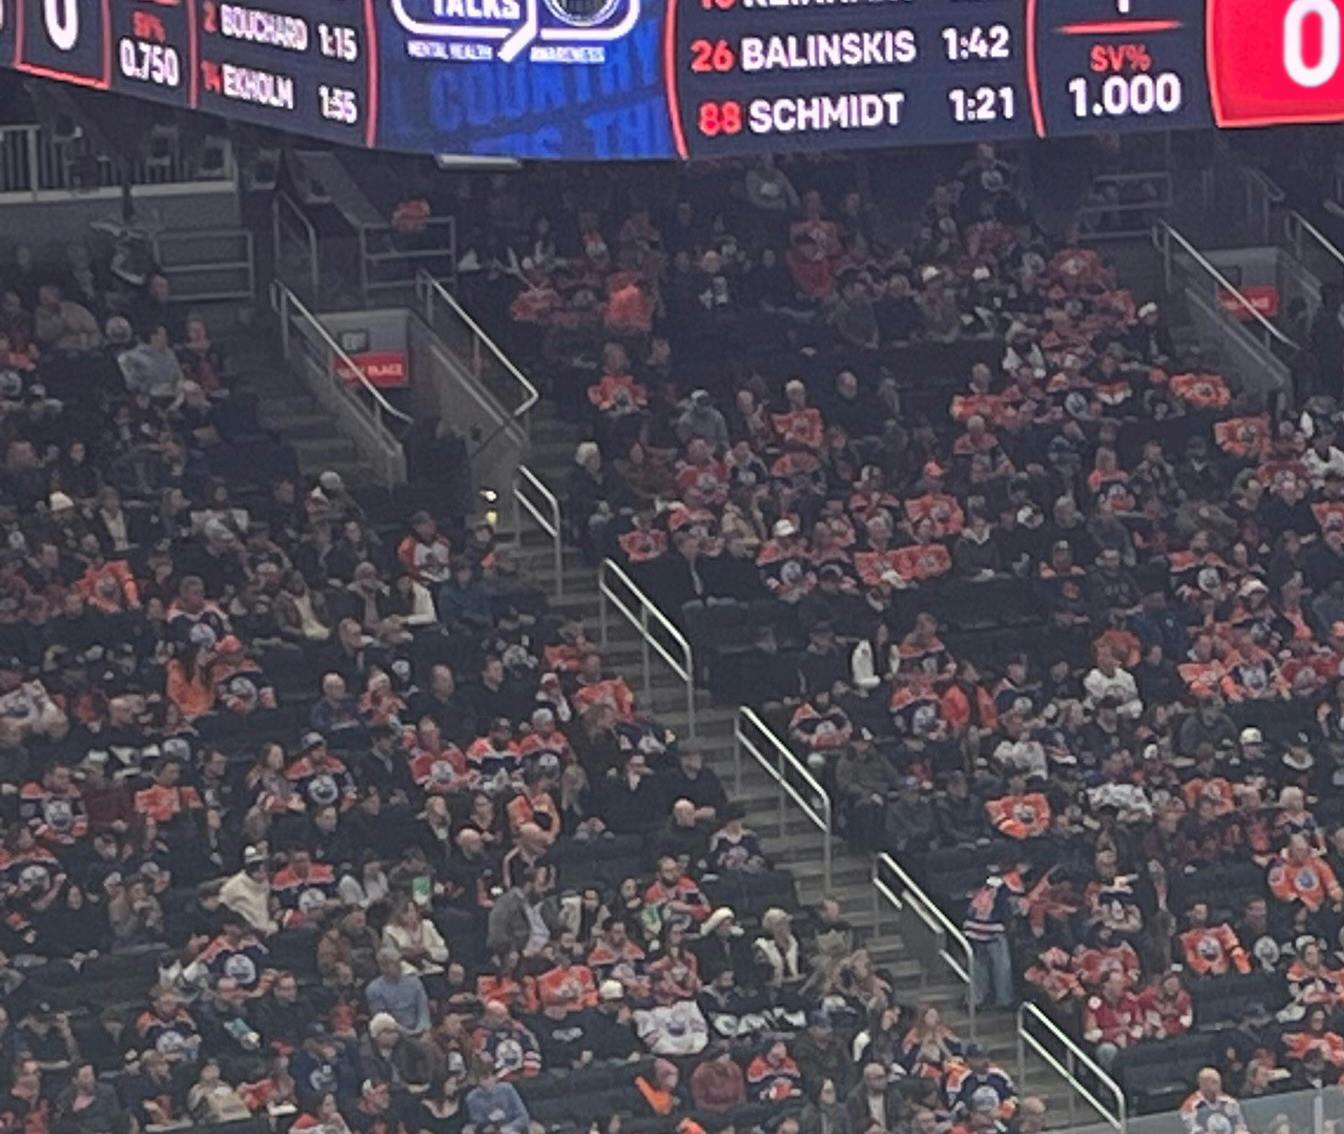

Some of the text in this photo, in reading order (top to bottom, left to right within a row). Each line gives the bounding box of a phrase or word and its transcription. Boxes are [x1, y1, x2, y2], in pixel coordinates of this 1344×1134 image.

[220, 4, 308, 50] BOUCHARD
[318, 24, 358, 61] 1:15
[690, 26, 1010, 72] 26 BALINSKIS 1:42
[1283, 0, 1341, 88] 0
[119, 38, 180, 86] 0.750
[1090, 45, 1151, 72] SV%
[222, 64, 294, 110] EKHOLM
[319, 85, 358, 123] 1:55
[699, 86, 1014, 136] 88 SCHMIDT 1:21
[1068, 73, 1181, 117] 1.000
